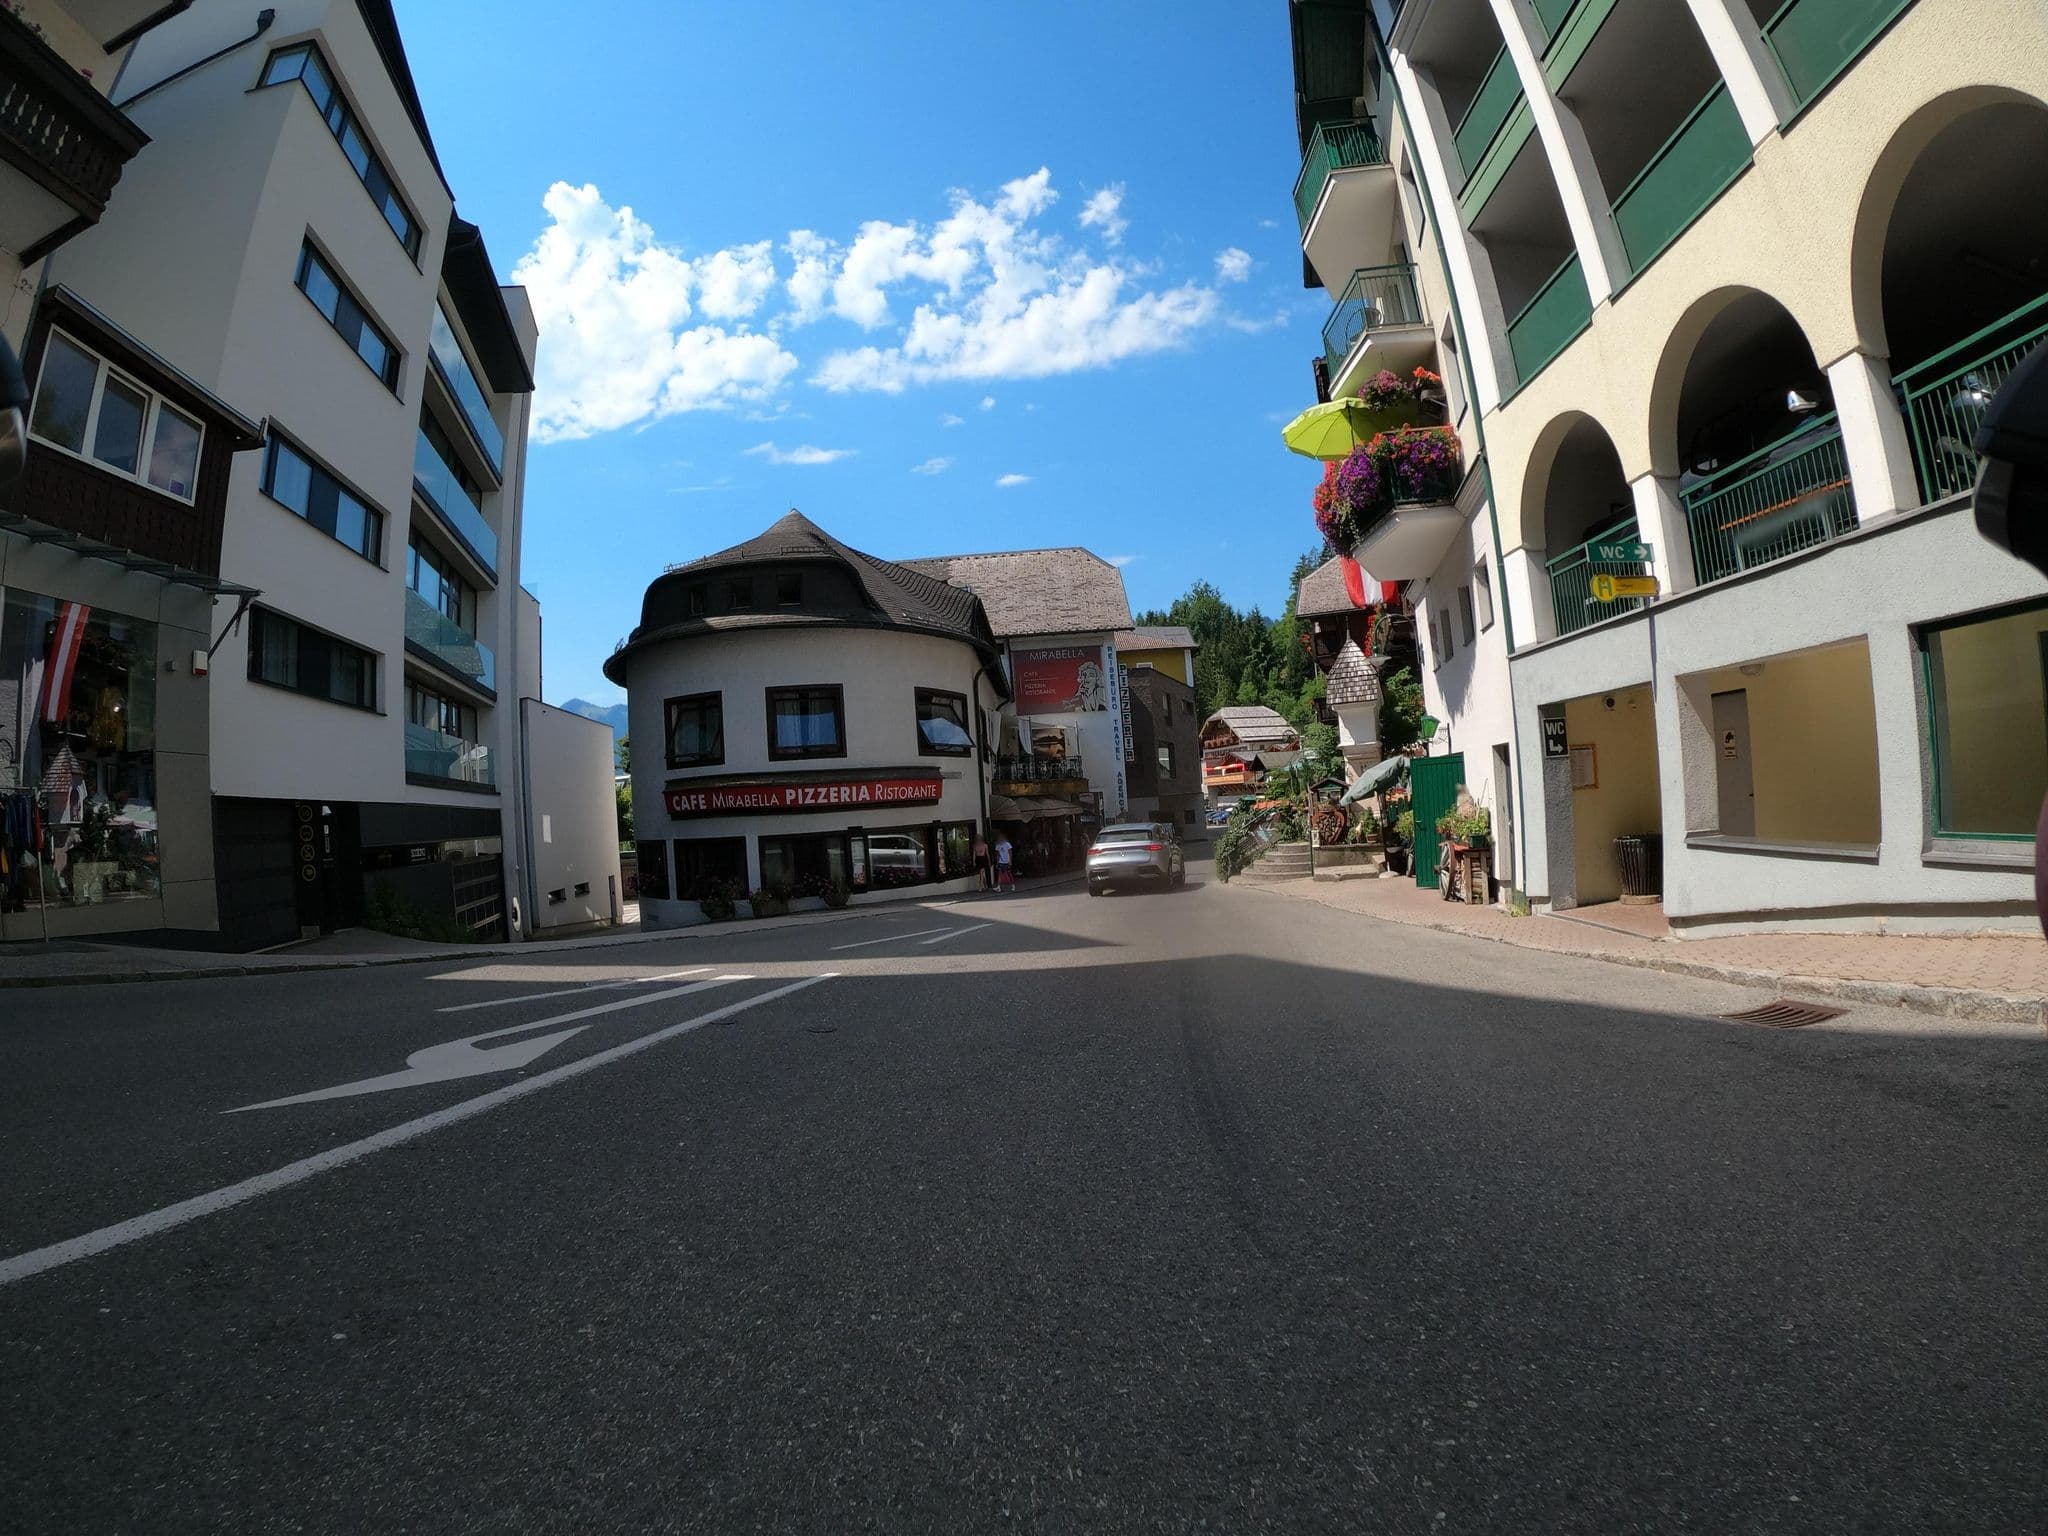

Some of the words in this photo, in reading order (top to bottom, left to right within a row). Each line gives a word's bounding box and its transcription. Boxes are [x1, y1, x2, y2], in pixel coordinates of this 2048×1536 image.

[1599, 545, 1625, 559] WC
[1029, 649, 1085, 661] MIRABELLA
[1545, 721, 1564, 736] WC
[1112, 719, 1121, 761] TRAVEL
[672, 794, 707, 812] CAFE
[785, 785, 870, 805] PIZZERIA
